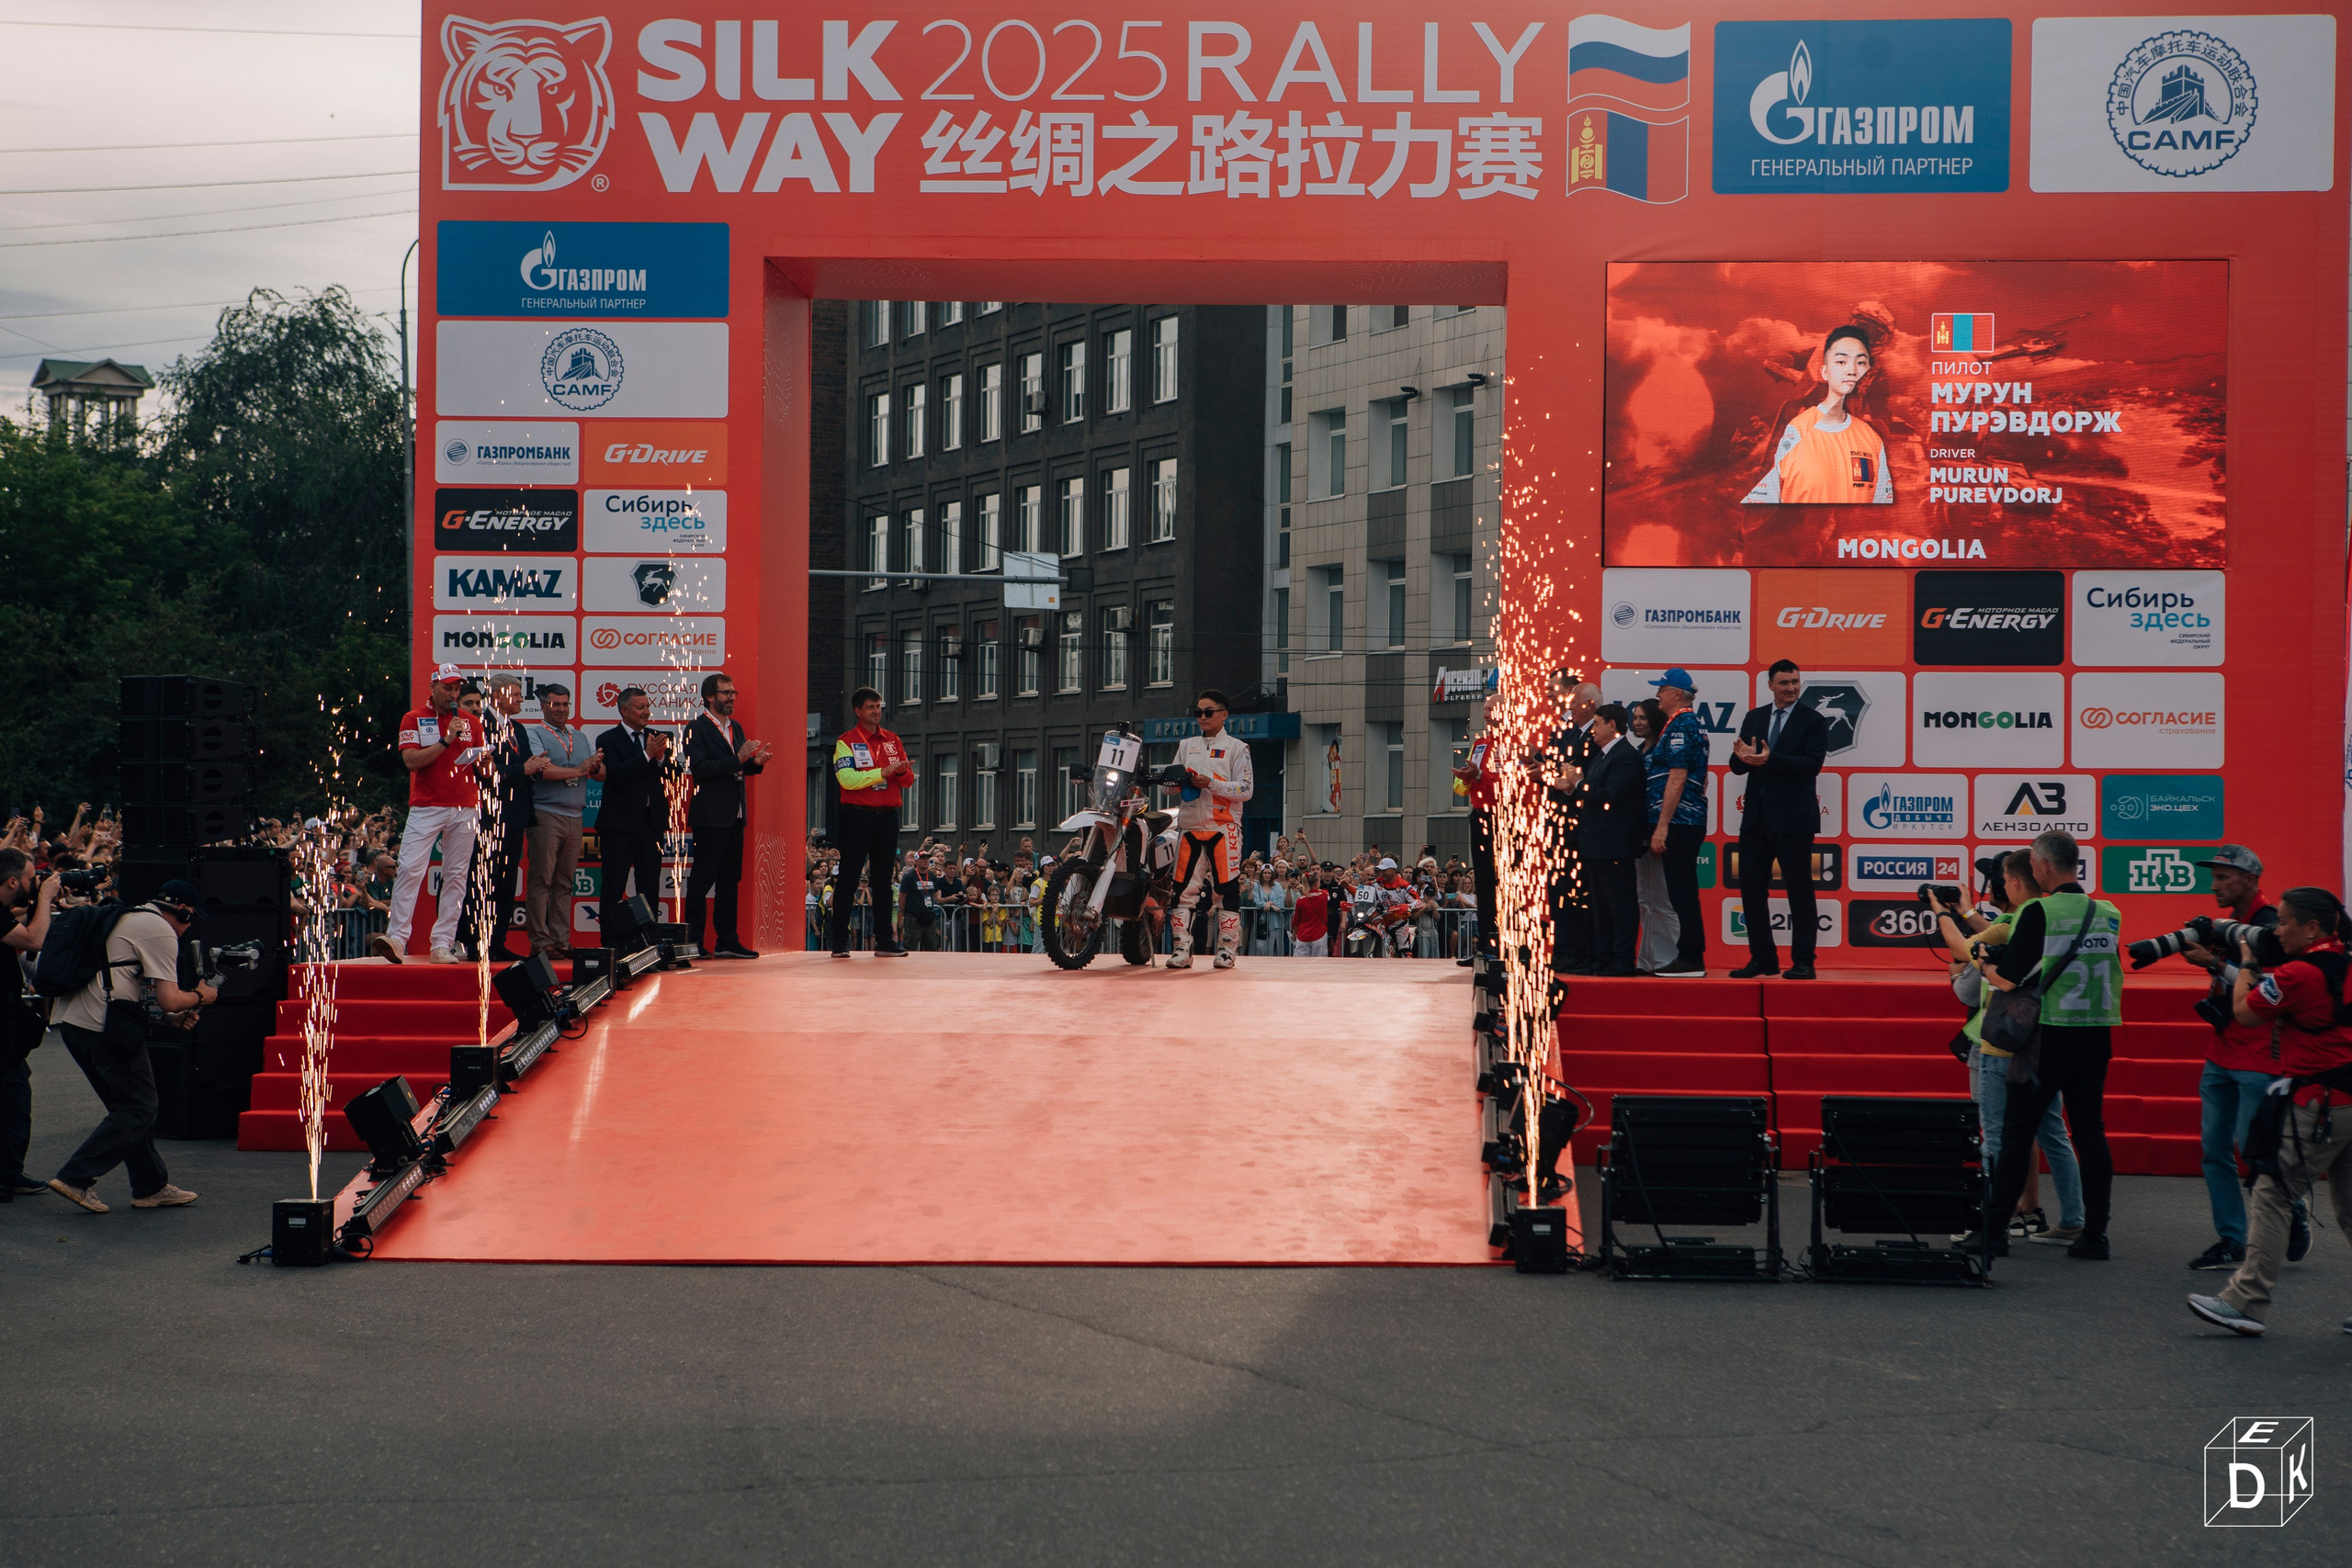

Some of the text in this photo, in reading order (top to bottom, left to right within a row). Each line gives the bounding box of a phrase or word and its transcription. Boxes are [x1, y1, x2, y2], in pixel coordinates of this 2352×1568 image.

[637, 18, 904, 101] SILK
[920, 19, 1545, 104] 2025 RALLY
[2116, 39, 2249, 117] 中国汽车摩托车运动联合会
[1817, 106, 1974, 145] ГАЗПРОМ
[2128, 130, 2235, 150] CAMF
[637, 112, 904, 193] WAY
[920, 109, 1544, 200] 丝绸之路拉力赛
[1751, 155, 1973, 176] ГЕНЕРАЛЬНЫЙ ПАРТНЕР
[558, 269, 646, 291] ГАЗПРОМ
[522, 297, 646, 310] ГЕНЕРАЛЬНЫЙ ПАРТНЕР
[1931, 361, 1992, 376] ПИЛОТ
[553, 384, 612, 396] CAMF
[1931, 382, 2032, 404] МУРУН
[1930, 411, 2122, 436] ПУРЭВДОРЖ
[477, 446, 571, 459] ГАЗПРОМБАНК
[1929, 448, 1975, 458] DRIVER
[1929, 468, 2008, 484] MURUN
[1929, 487, 2063, 504] PUREVDORJ
[605, 495, 695, 517] Сибирь
[640, 516, 706, 533] здесь
[1837, 538, 1986, 559] MONGOLIA
[448, 569, 562, 599] KAMAZ
[2086, 587, 2194, 613] Сибирь
[1645, 609, 1741, 623] ГАЗПРОМБАНК
[2130, 612, 2211, 631] здесь
[444, 631, 565, 649] MONGOLIA
[623, 633, 717, 646] СОГЛАСИЕ
[647, 697, 705, 708] ХАНИКА
[1613, 701, 1736, 733] KAZ
[1923, 711, 2053, 728] MONGOLIA
[2115, 711, 2216, 725] СОГЛАСИЕ
[1155, 717, 1256, 738] ИРКУТТАТ
[2159, 727, 2216, 735] страхование
[1111, 749, 1125, 766] 11
[1894, 796, 1953, 812] ГАЗПРОМ
[2150, 794, 2216, 803] БАЙКАЛЬСК
[1894, 814, 1952, 822] ДОБЫЧА
[1982, 822, 2088, 832] ЛЕНЗОЛОТО
[1227, 823, 1238, 852] KFC
[1163, 842, 1175, 862] 11
[1863, 862, 1958, 875] РОССИЯ 24
[2129, 849, 2197, 892] НТВ
[1358, 891, 1369, 900] 50
[1880, 909, 1938, 935] 360
[2059, 960, 2113, 1010] 21
